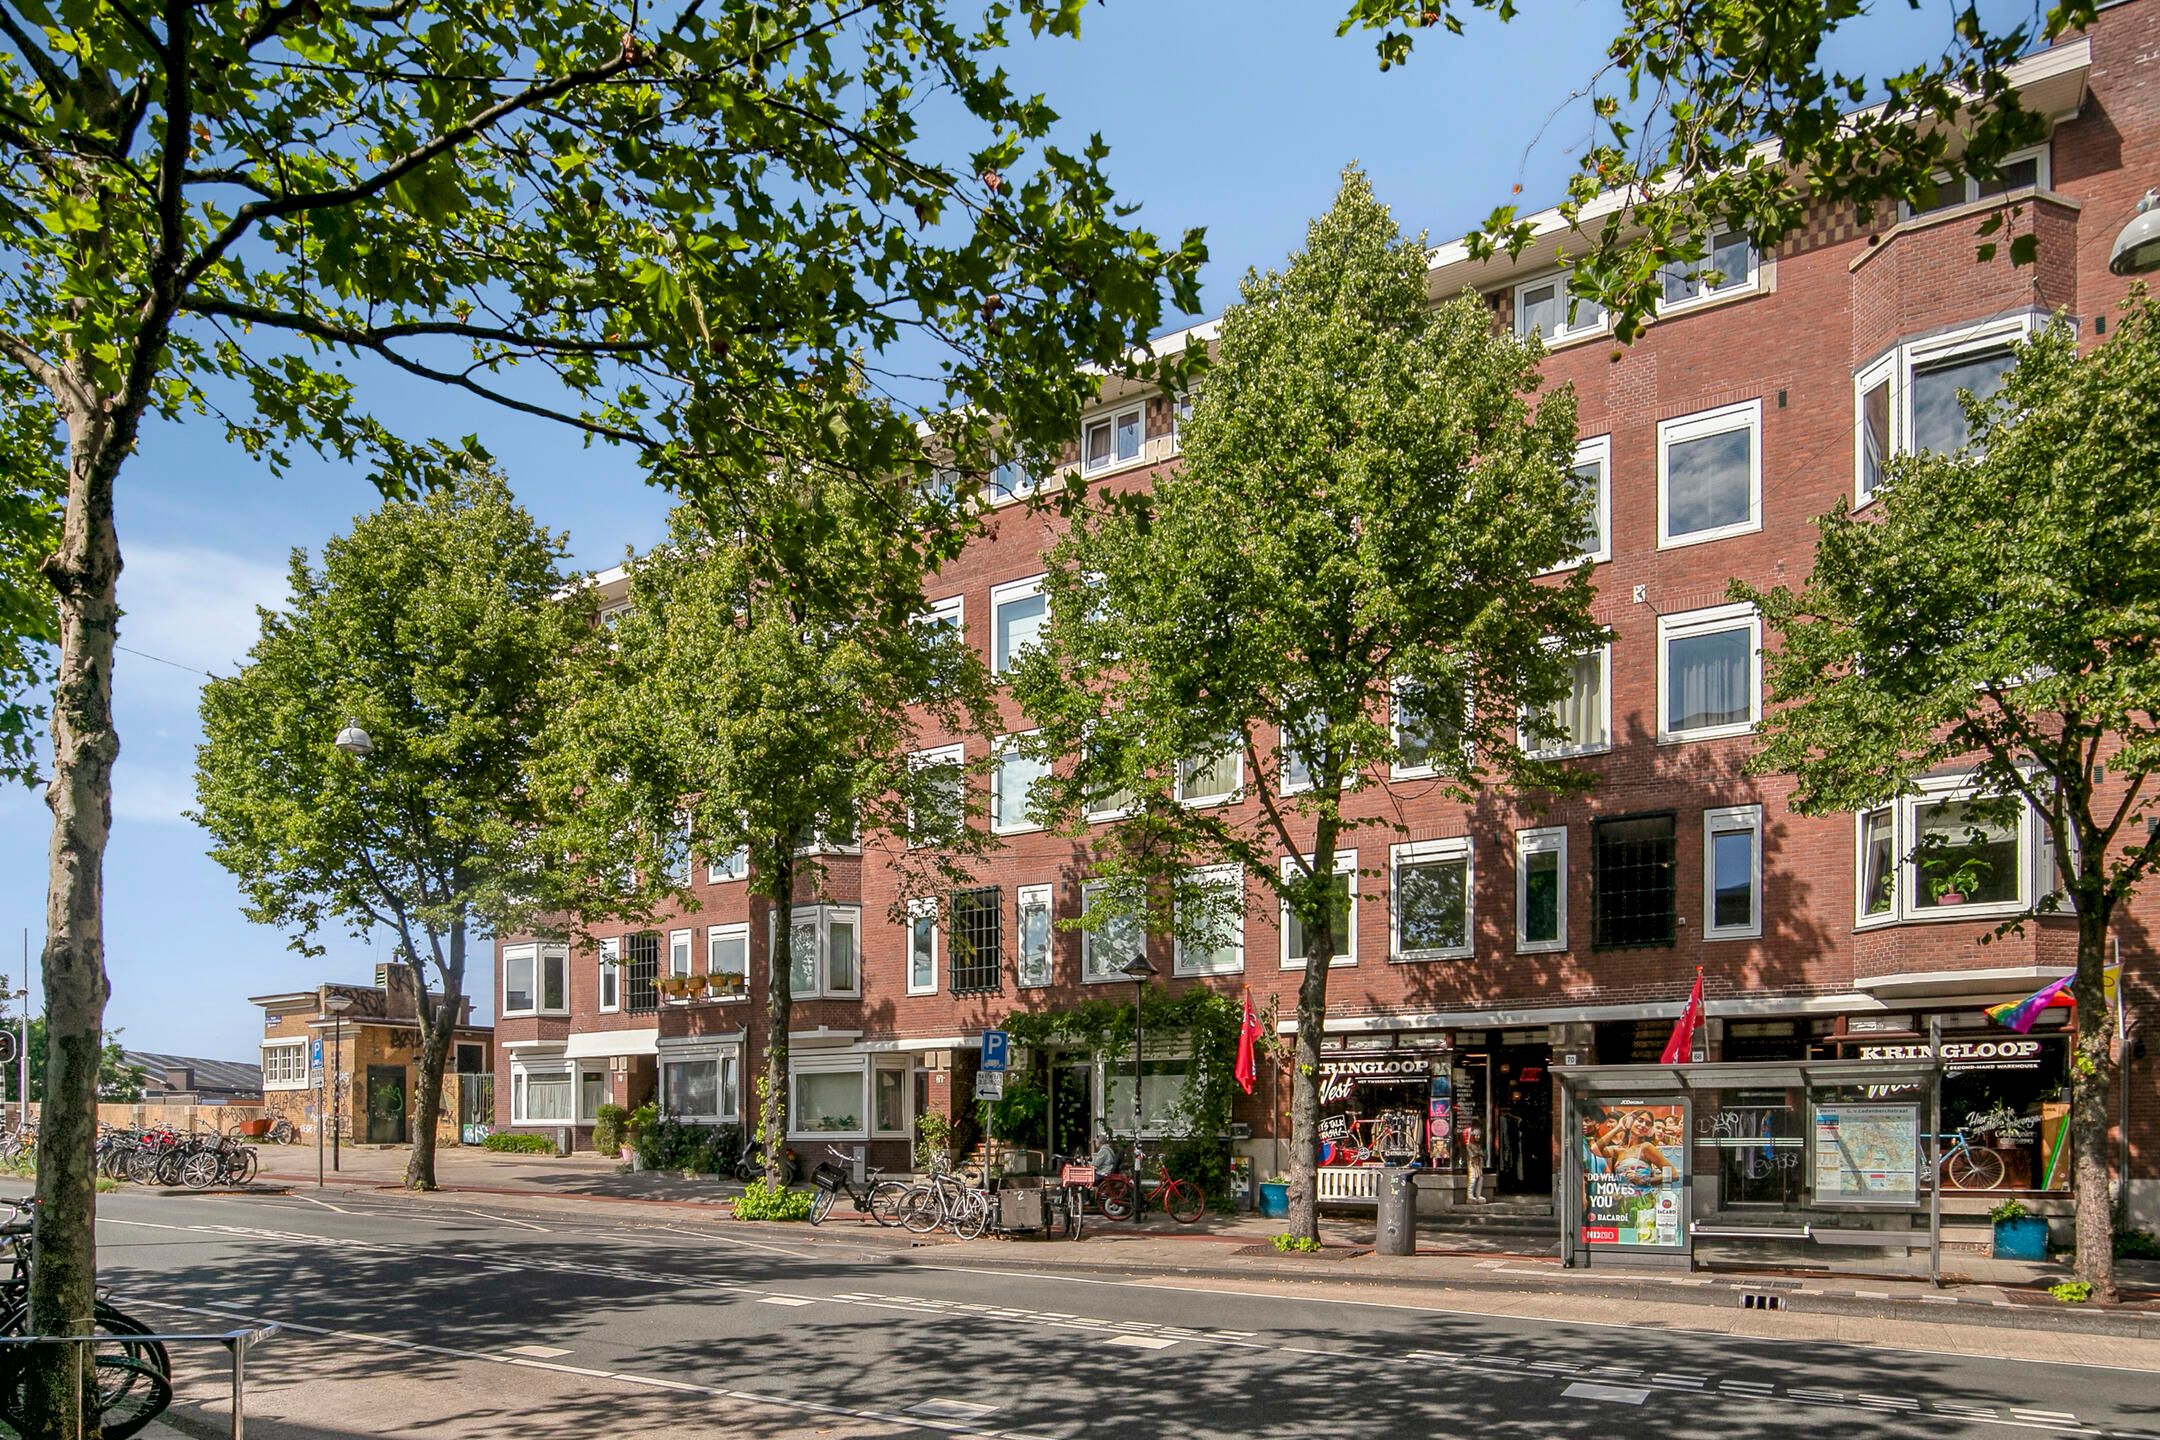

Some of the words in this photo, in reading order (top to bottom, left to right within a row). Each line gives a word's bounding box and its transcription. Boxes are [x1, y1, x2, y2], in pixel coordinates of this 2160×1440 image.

[314, 1042, 321, 1057] P
[988, 1034, 1003, 1055] P
[1860, 1042, 2039, 1060] KRINGLOOP
[1319, 1061, 1429, 1075] RINGLOOP
[1329, 1119, 1345, 1128] TALK
[1587, 1173, 1599, 1181] DO
[1600, 1173, 1622, 1181] WHAT
[1597, 1183, 1635, 1195] MOVES
[1017, 1190, 1024, 1201] 2
[1589, 1195, 1613, 1208] YOU
[1597, 1213, 1629, 1222] BACARDÍ
